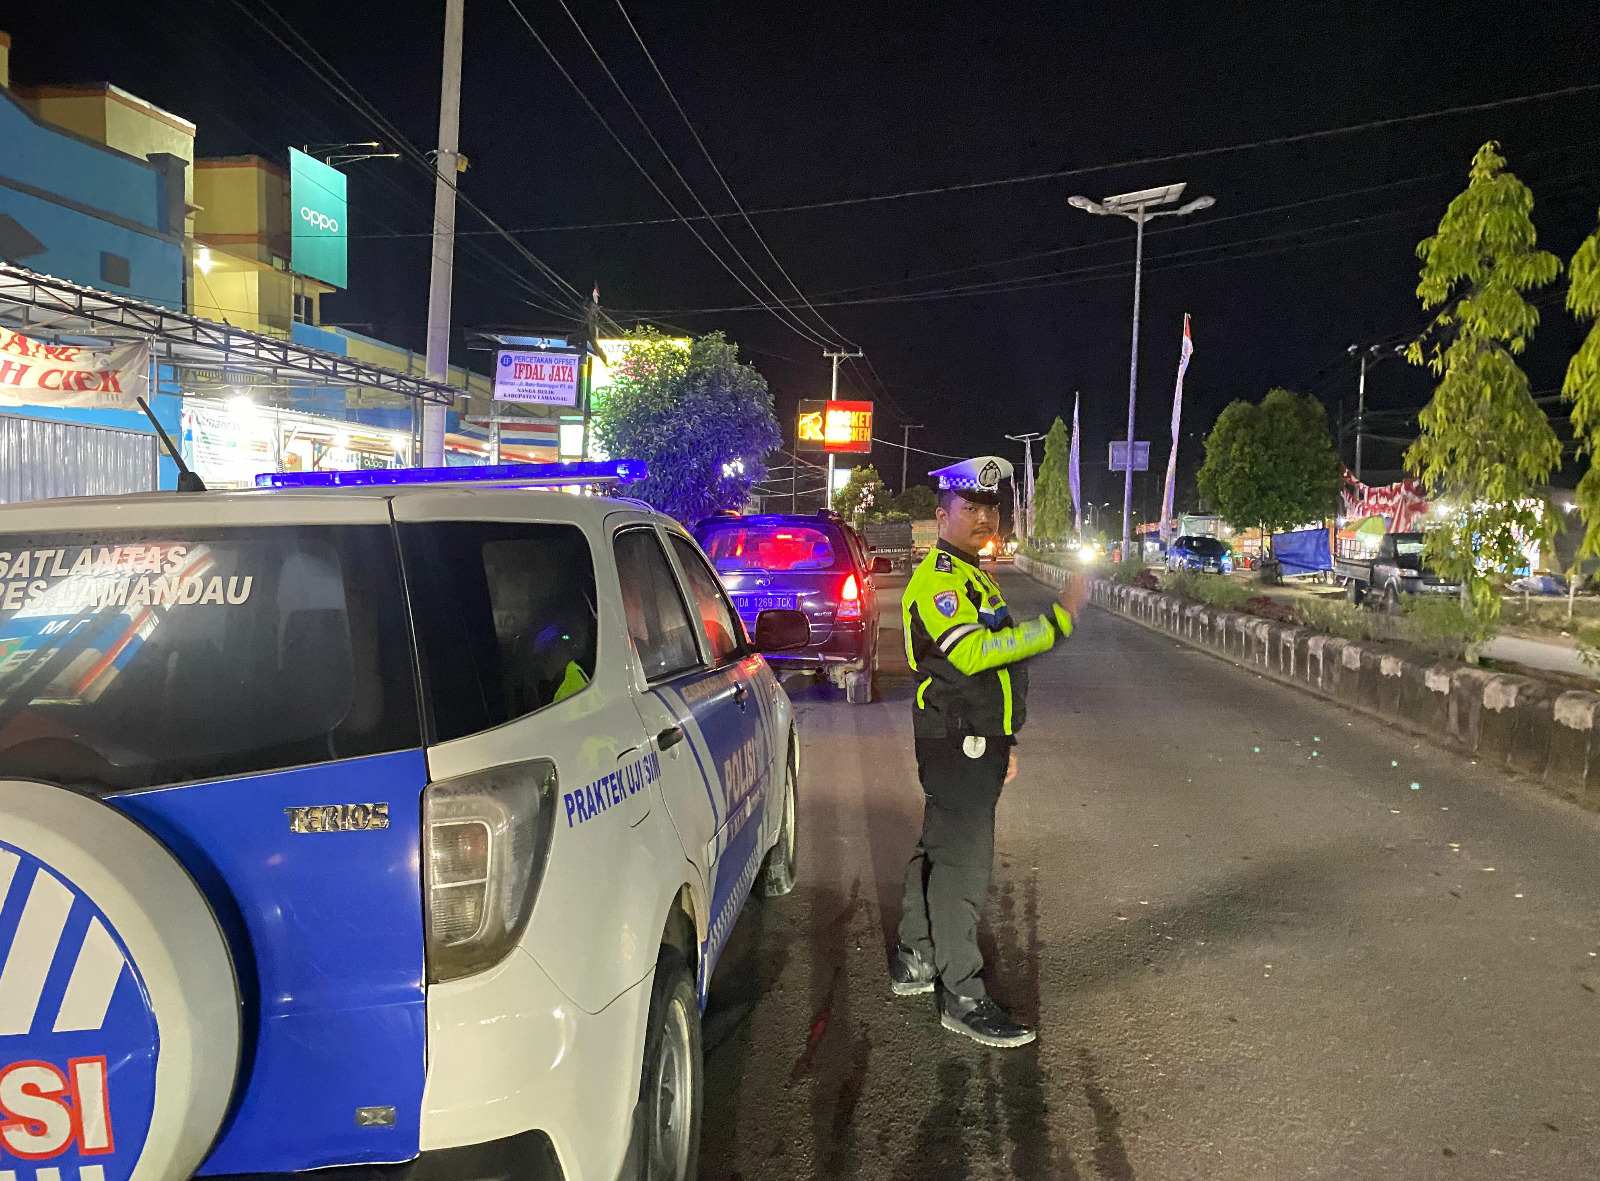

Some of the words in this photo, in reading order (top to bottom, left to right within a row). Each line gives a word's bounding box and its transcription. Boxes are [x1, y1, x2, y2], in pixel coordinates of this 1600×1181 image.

[301, 206, 338, 232] oppo
[513, 363, 546, 381] IFDAL
[549, 365, 574, 382] JAYA
[514, 355, 553, 365] PERCETAKAN
[554, 358, 577, 366] OFFSET
[829, 410, 872, 427] CKET
[0, 579, 48, 610] ES
[55, 576, 253, 608] LAMANDAU
[739, 597, 749, 608] DA
[754, 597, 773, 608] 1269
[776, 597, 792, 608] TCK
[724, 737, 757, 813] POLISI
[564, 768, 628, 828] PRAKTEK
[625, 760, 645, 795] UJI
[643, 750, 661, 785] SIM
[283, 802, 390, 834] TERIOS
